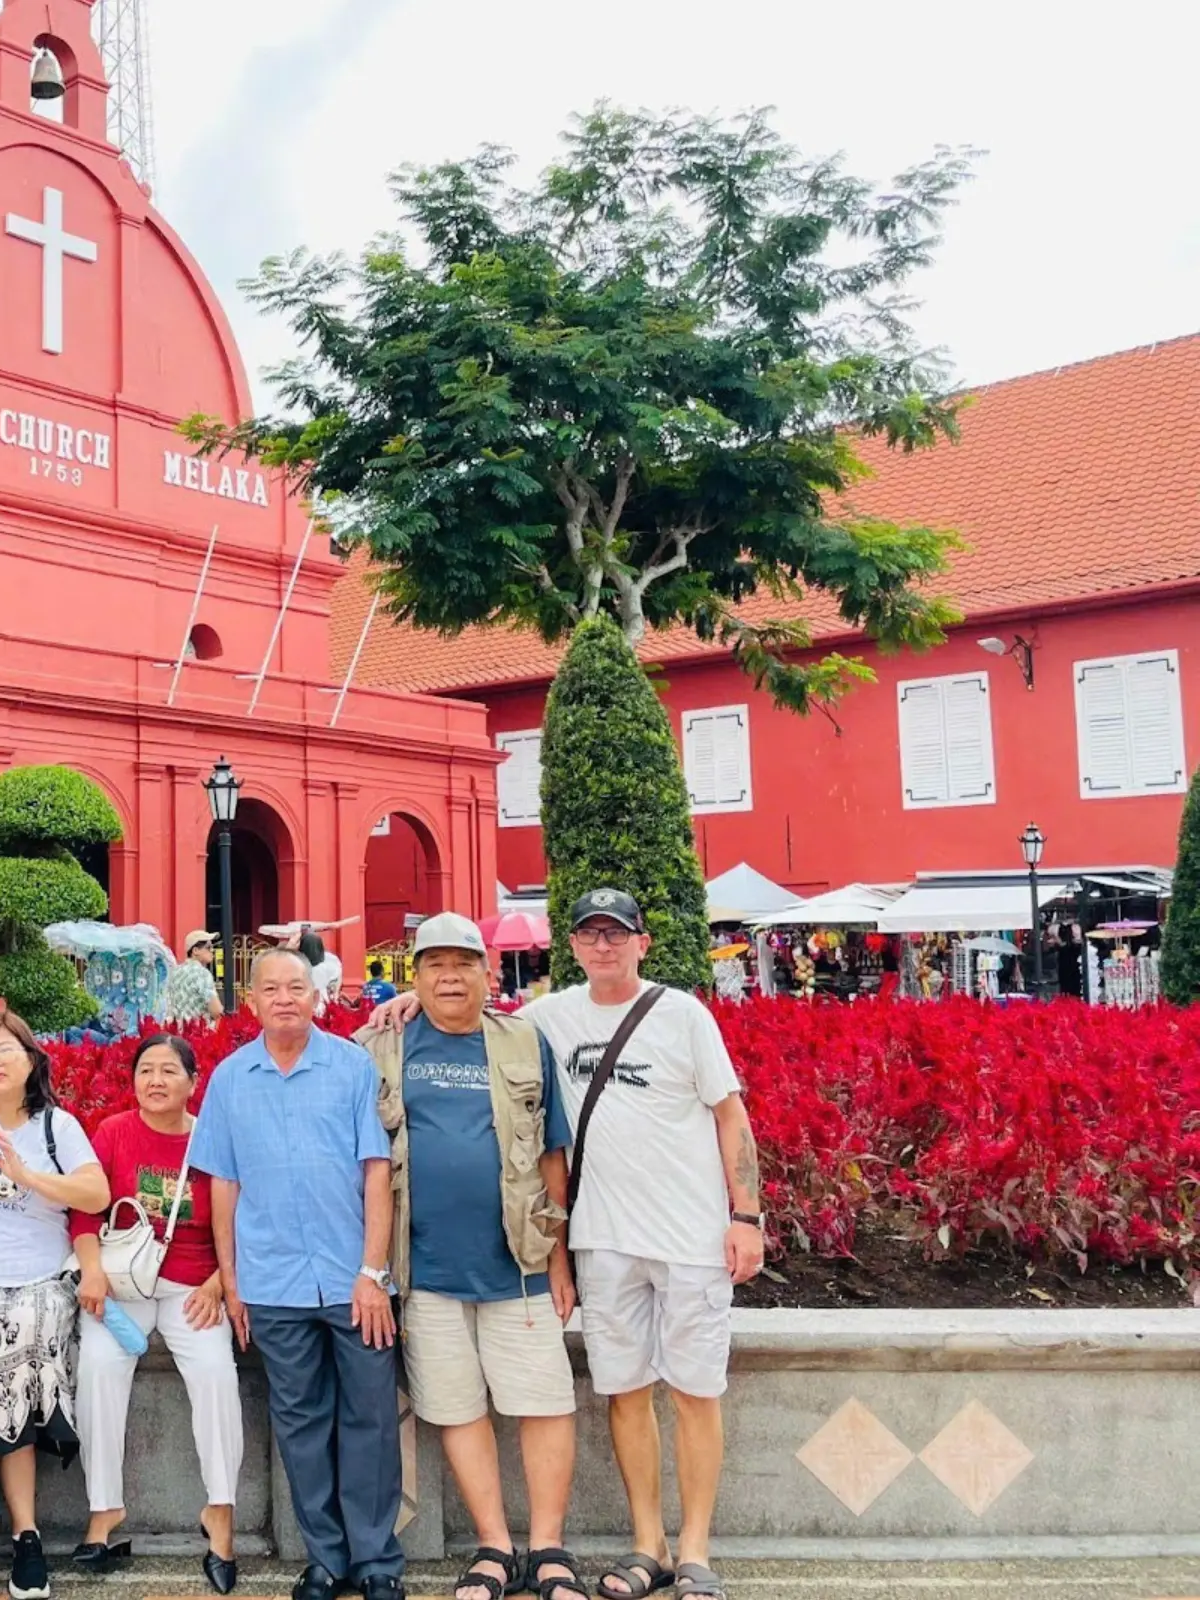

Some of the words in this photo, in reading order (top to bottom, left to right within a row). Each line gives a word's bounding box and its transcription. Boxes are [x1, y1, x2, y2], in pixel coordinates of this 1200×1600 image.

[0, 408, 110, 469] CHURCH
[163, 450, 269, 507] MELAKA
[29, 455, 82, 488] 1753
